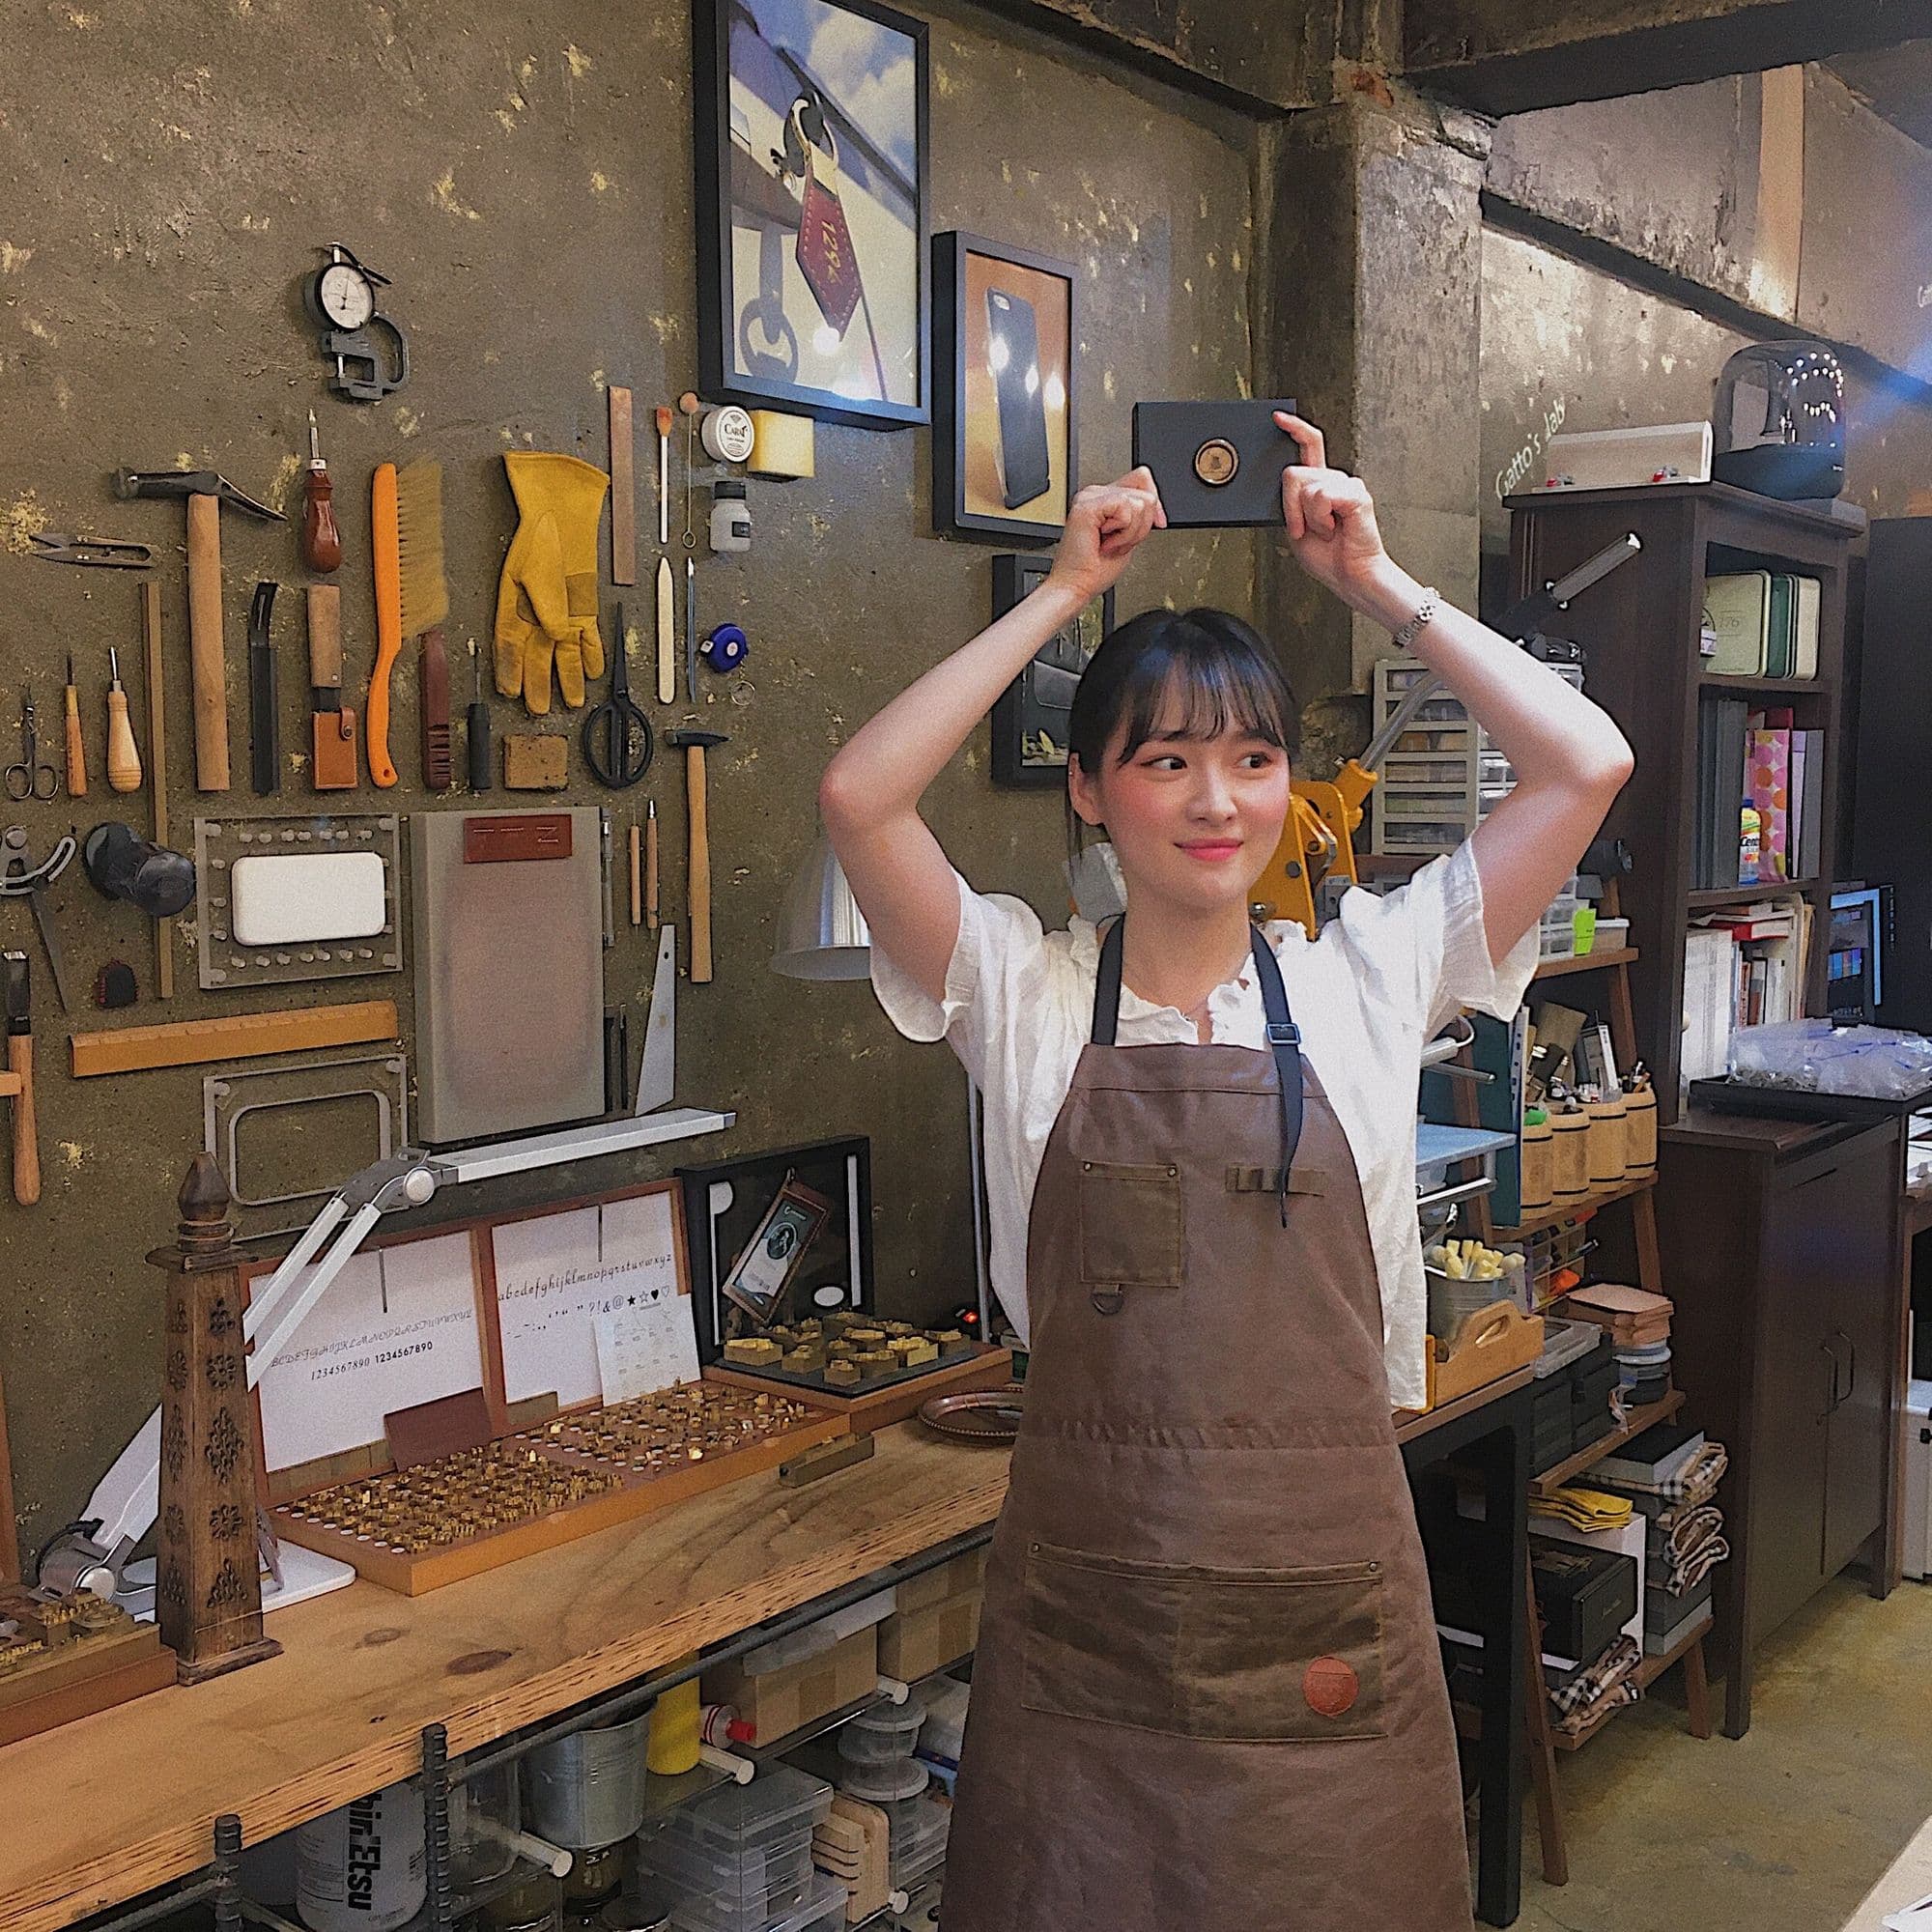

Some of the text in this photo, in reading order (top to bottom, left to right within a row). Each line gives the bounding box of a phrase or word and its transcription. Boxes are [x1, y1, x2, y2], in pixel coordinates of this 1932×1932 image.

[1495, 434, 1542, 500] Gatto's
[1740, 837, 1759, 847] Cent
[270, 1310, 472, 1368] BCDEFGHIJKLMNOPQRSTUVWXYZ
[311, 1340, 434, 1381] 1234567890 1234567890
